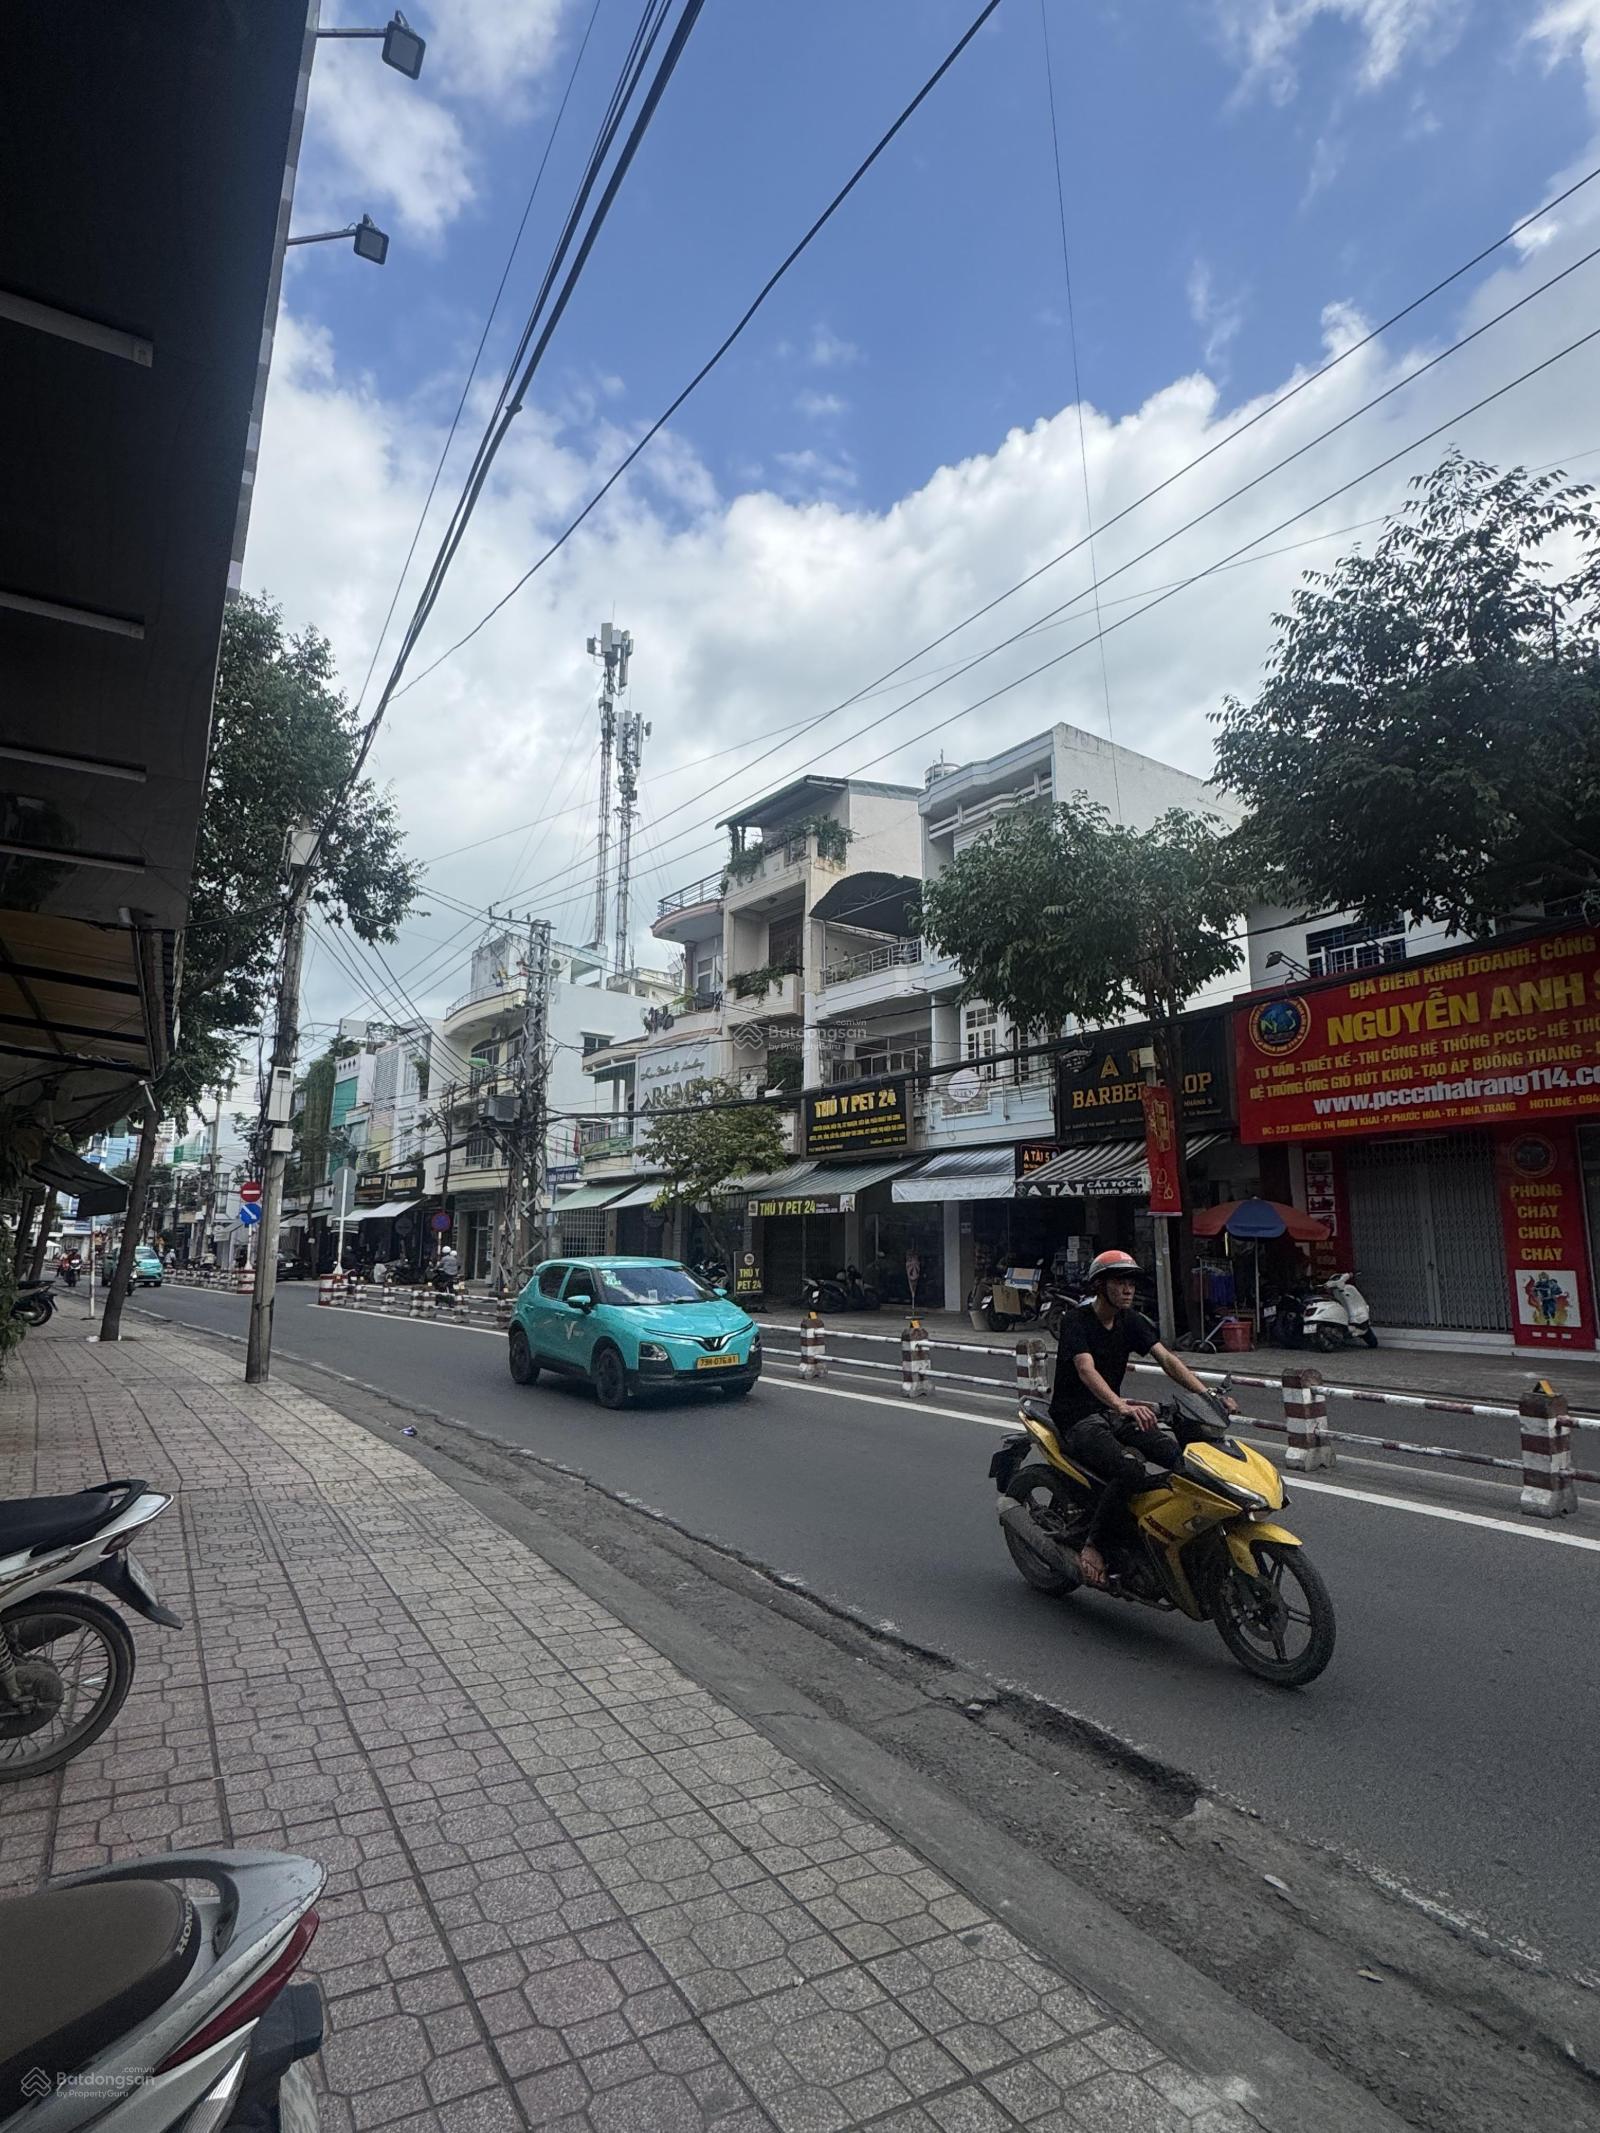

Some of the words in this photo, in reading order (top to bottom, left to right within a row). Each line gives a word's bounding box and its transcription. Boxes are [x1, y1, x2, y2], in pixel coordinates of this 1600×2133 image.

[1540, 934, 1596, 960] CÔNG
[1328, 986, 1480, 1046] NGUYỄN
[1490, 972, 1586, 1020] ANH
[1382, 1044, 1418, 1061] CÔNG
[1420, 1039, 1439, 1057] HỆ
[1441, 1032, 1489, 1053] THỐNG
[1493, 1027, 1538, 1046] PCCC
[1547, 1018, 1570, 1039] HỆ
[1100, 1054, 1120, 1079] A
[1354, 1070, 1378, 1086] HÚT
[1381, 1064, 1414, 1083] KHÓI
[1420, 1061, 1447, 1079] TẠO
[1451, 1056, 1470, 1074] ÁP
[1526, 1044, 1582, 1065] THANG
[840, 1097, 849, 1114] Y
[851, 1091, 875, 1113] PET
[878, 1088, 897, 1108] 24
[1461, 1106, 1480, 1116] NHA
[1482, 1101, 1517, 1113] TRANG
[1023, 1150, 1030, 1161] A
[1031, 1150, 1044, 1162] TÀI
[1027, 1185, 1042, 1196] A
[1047, 1181, 1085, 1196] TÀI
[1111, 1179, 1135, 1188] TÓC
[1510, 1182, 1562, 1199] PHÒNG
[778, 1202, 785, 1215] Y
[785, 1201, 802, 1215] PET
[803, 1200, 816, 1214] 24
[1517, 1203, 1560, 1219] CHÁY
[1518, 1223, 1562, 1240] CHỮA
[1521, 1246, 1564, 1261] CHÁY
[737, 1281, 751, 1290] PET
[752, 1281, 761, 1289] 24
